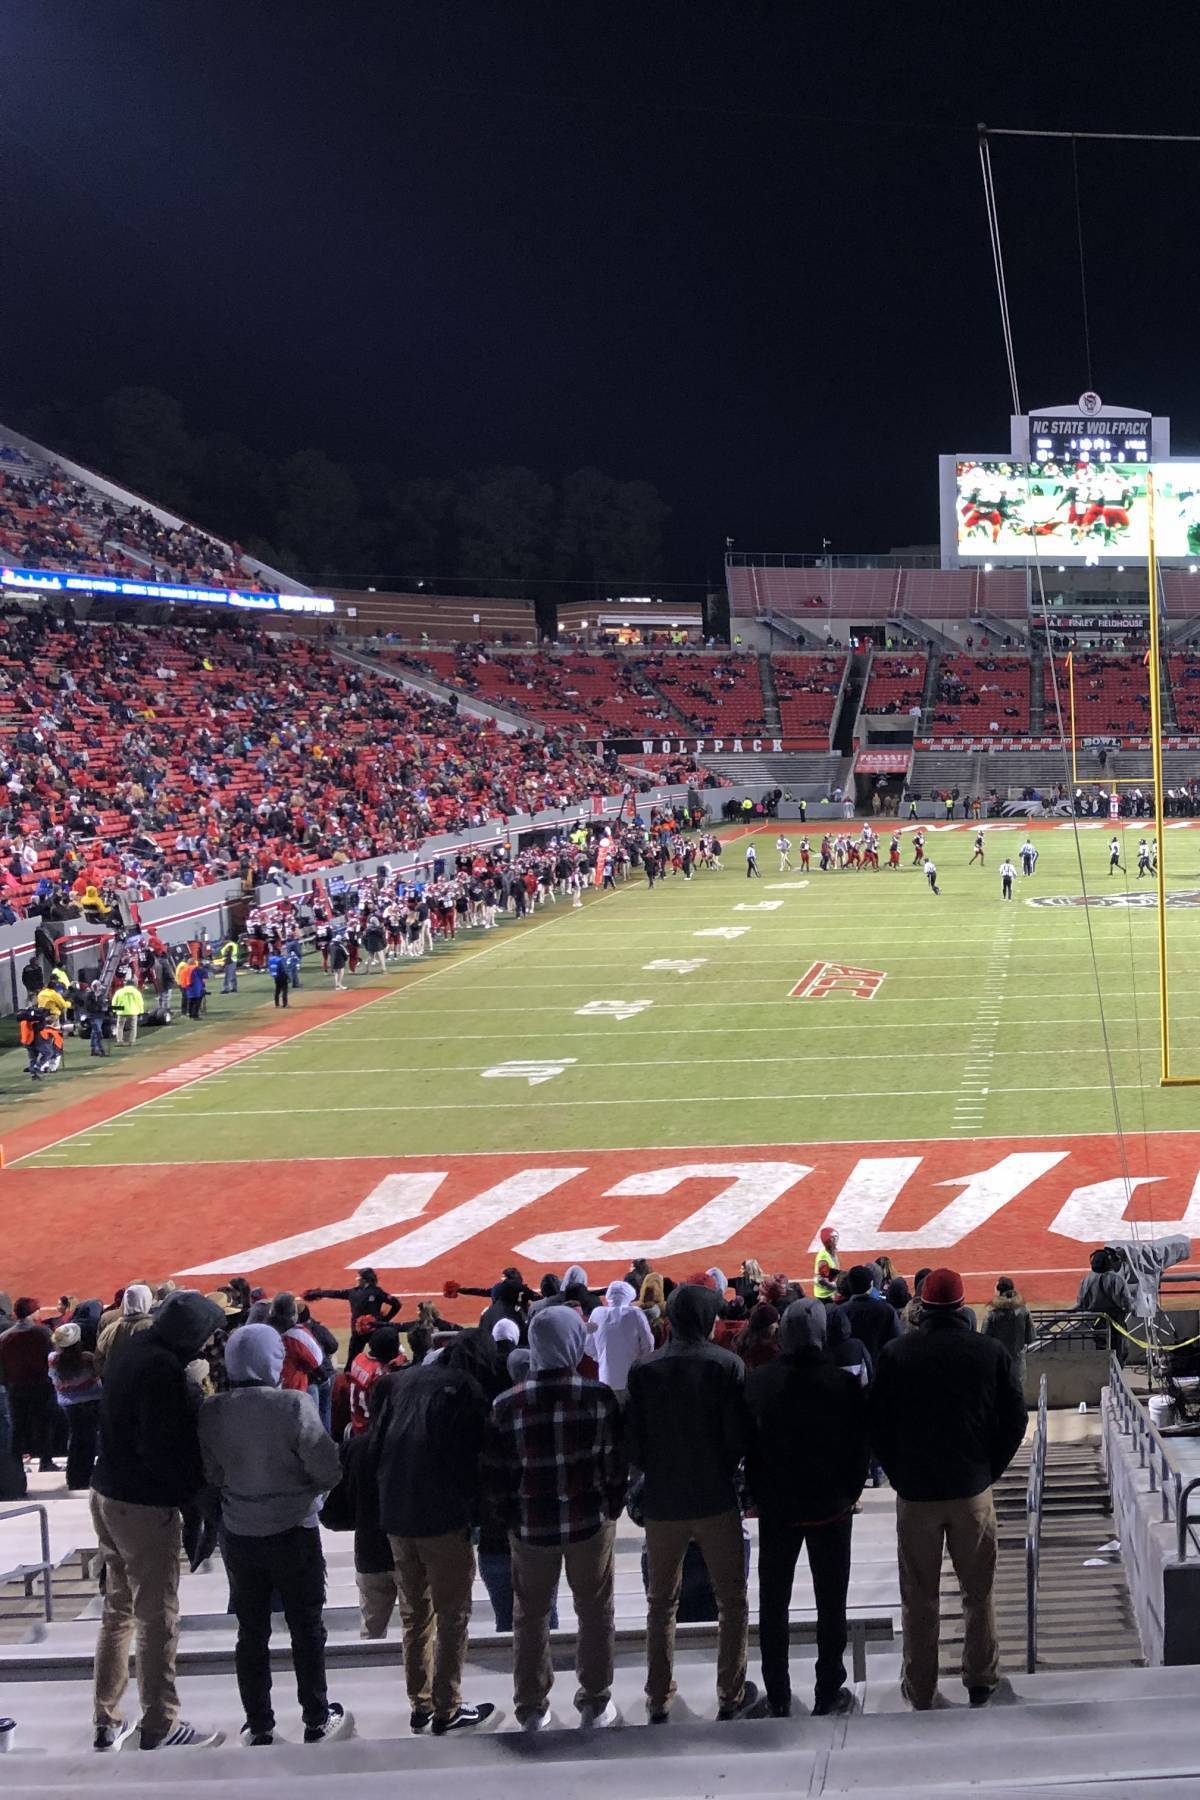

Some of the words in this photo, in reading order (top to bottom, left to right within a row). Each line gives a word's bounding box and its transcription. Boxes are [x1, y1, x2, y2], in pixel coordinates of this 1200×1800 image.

[1033, 421, 1049, 434] NC
[1051, 421, 1085, 434] STATE
[1087, 421, 1149, 435] WOLFPACK
[1098, 618, 1144, 627] FIELDHOUSE
[1083, 737, 1120, 746] BOWL
[642, 739, 783, 754] WOLFPACK
[903, 823, 1017, 832] NC
